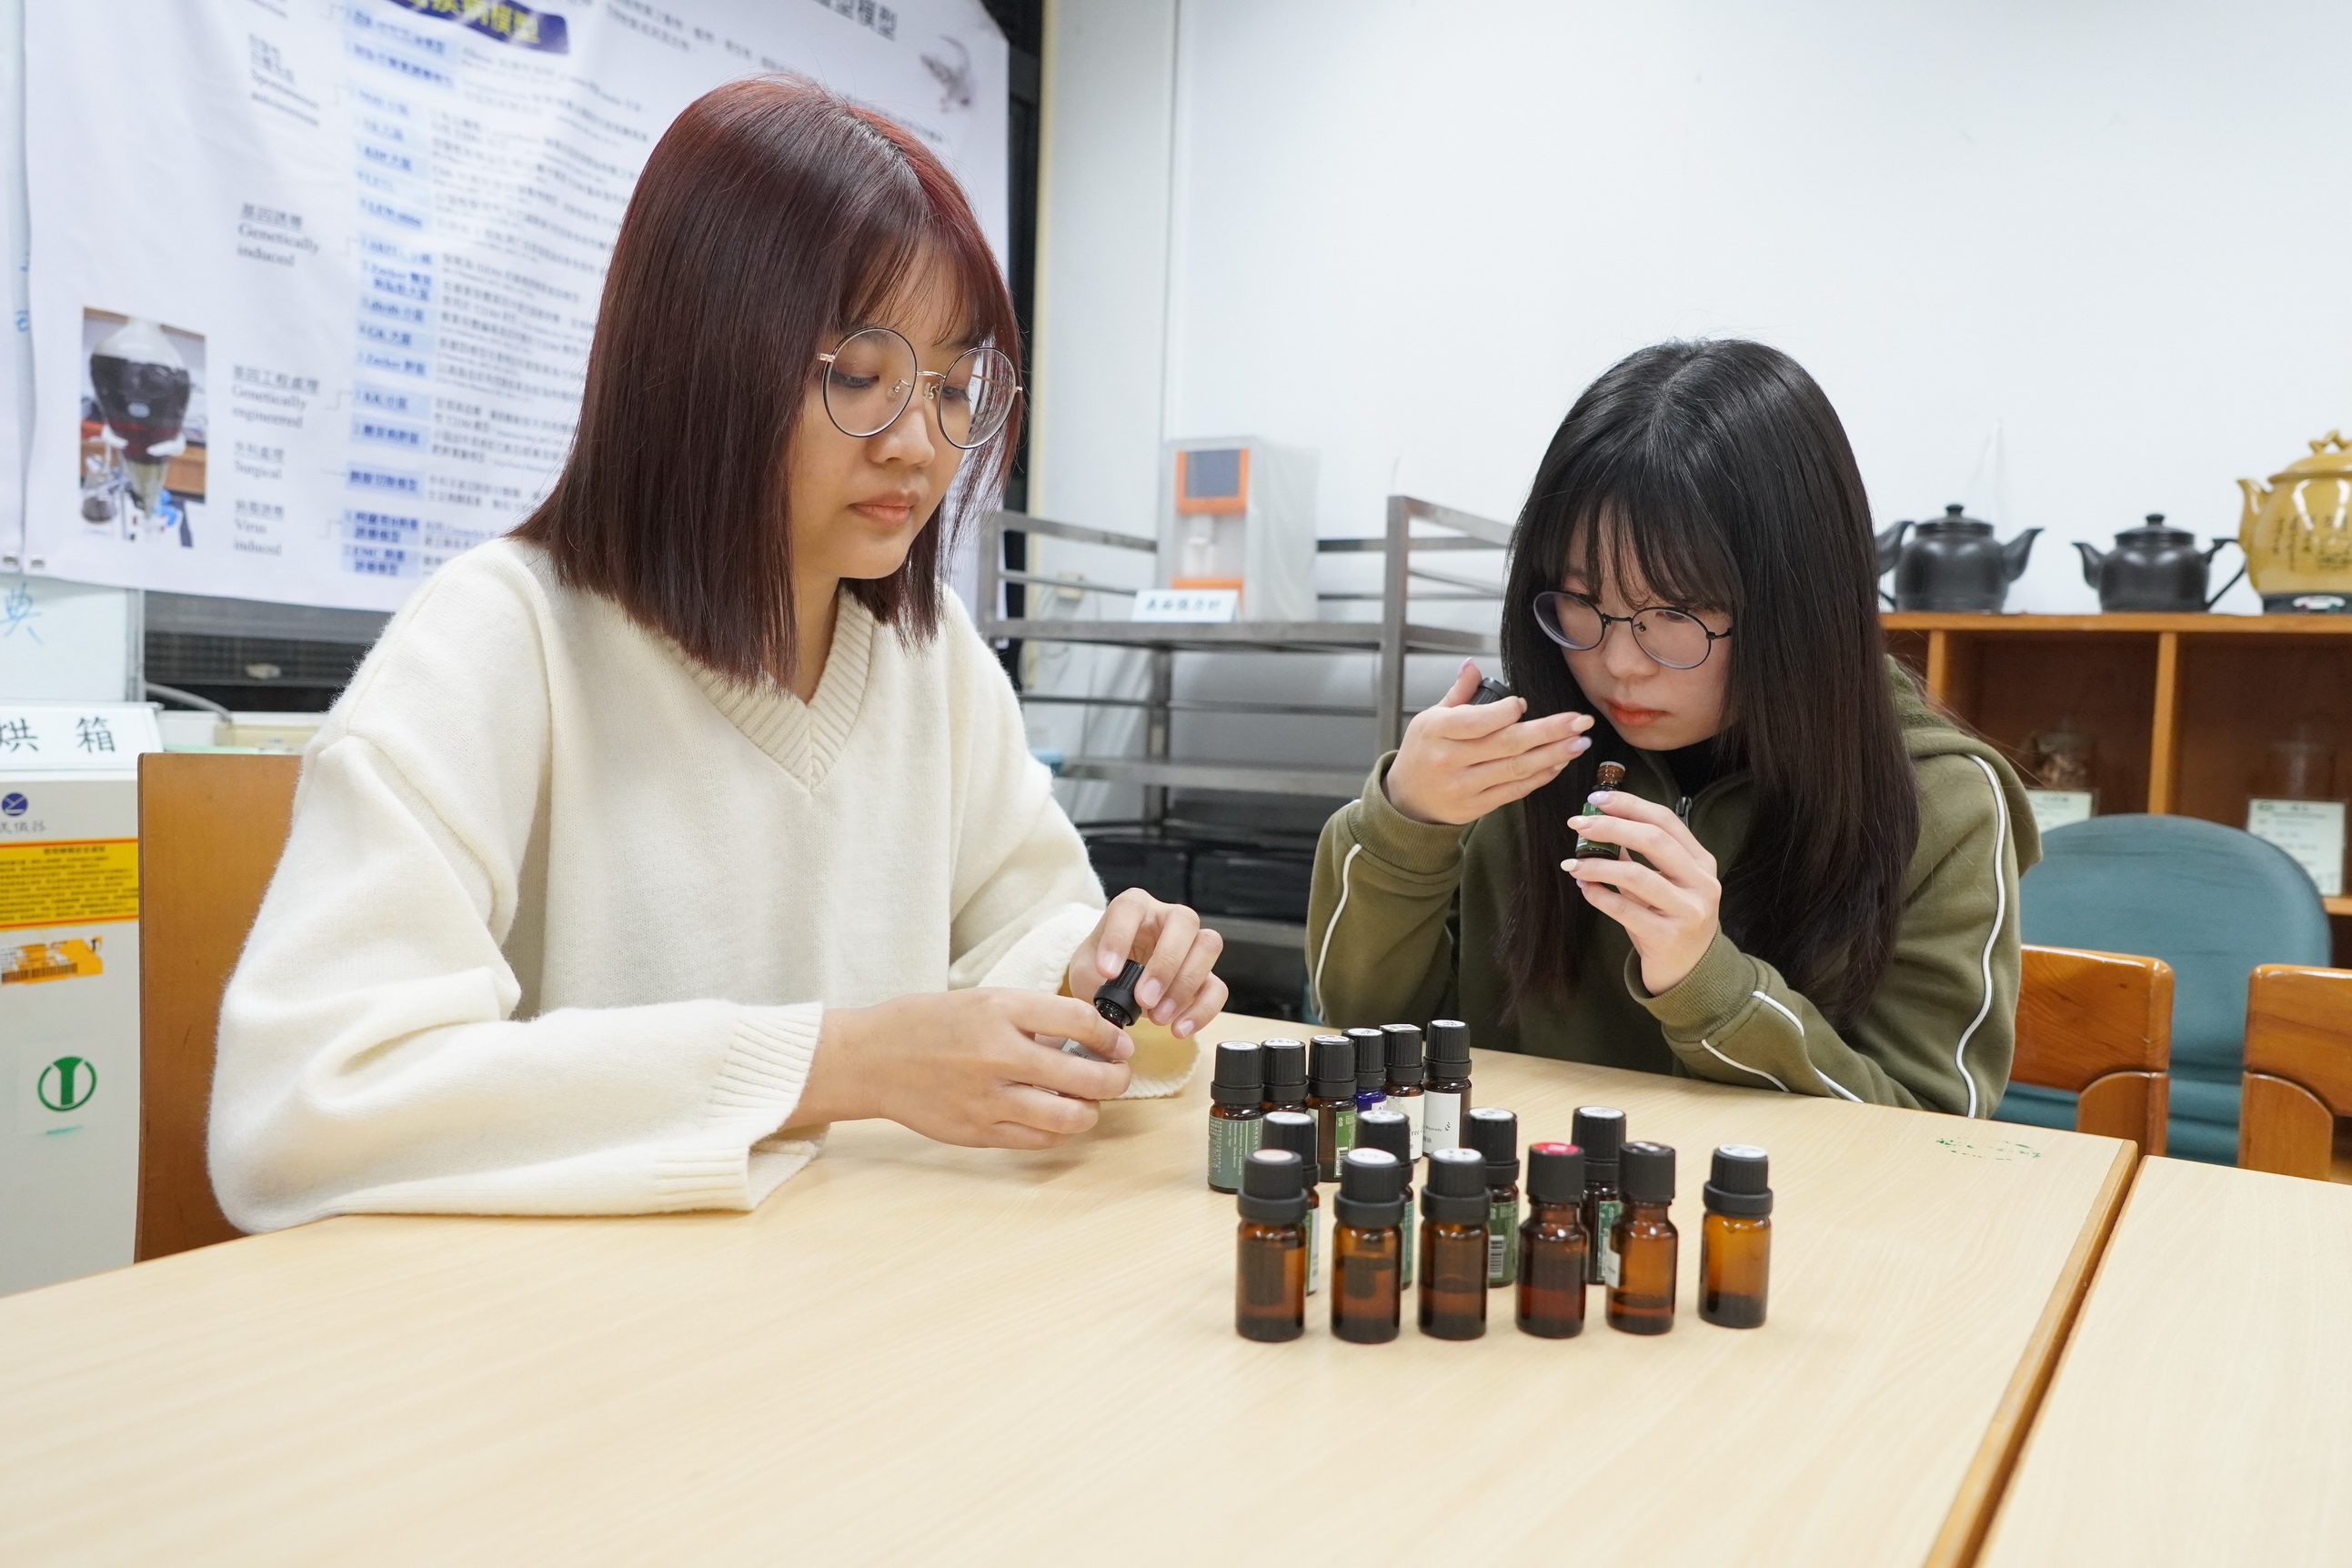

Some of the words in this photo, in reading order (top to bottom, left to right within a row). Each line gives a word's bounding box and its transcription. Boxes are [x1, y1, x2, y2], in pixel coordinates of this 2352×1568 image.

[237, 222, 320, 256] Genetically
[236, 243, 296, 266] induced
[231, 384, 307, 411] Genetically
[231, 407, 304, 429] engineered
[234, 460, 282, 480] Surgical
[234, 518, 267, 535] Virus
[233, 538, 282, 557] induced
